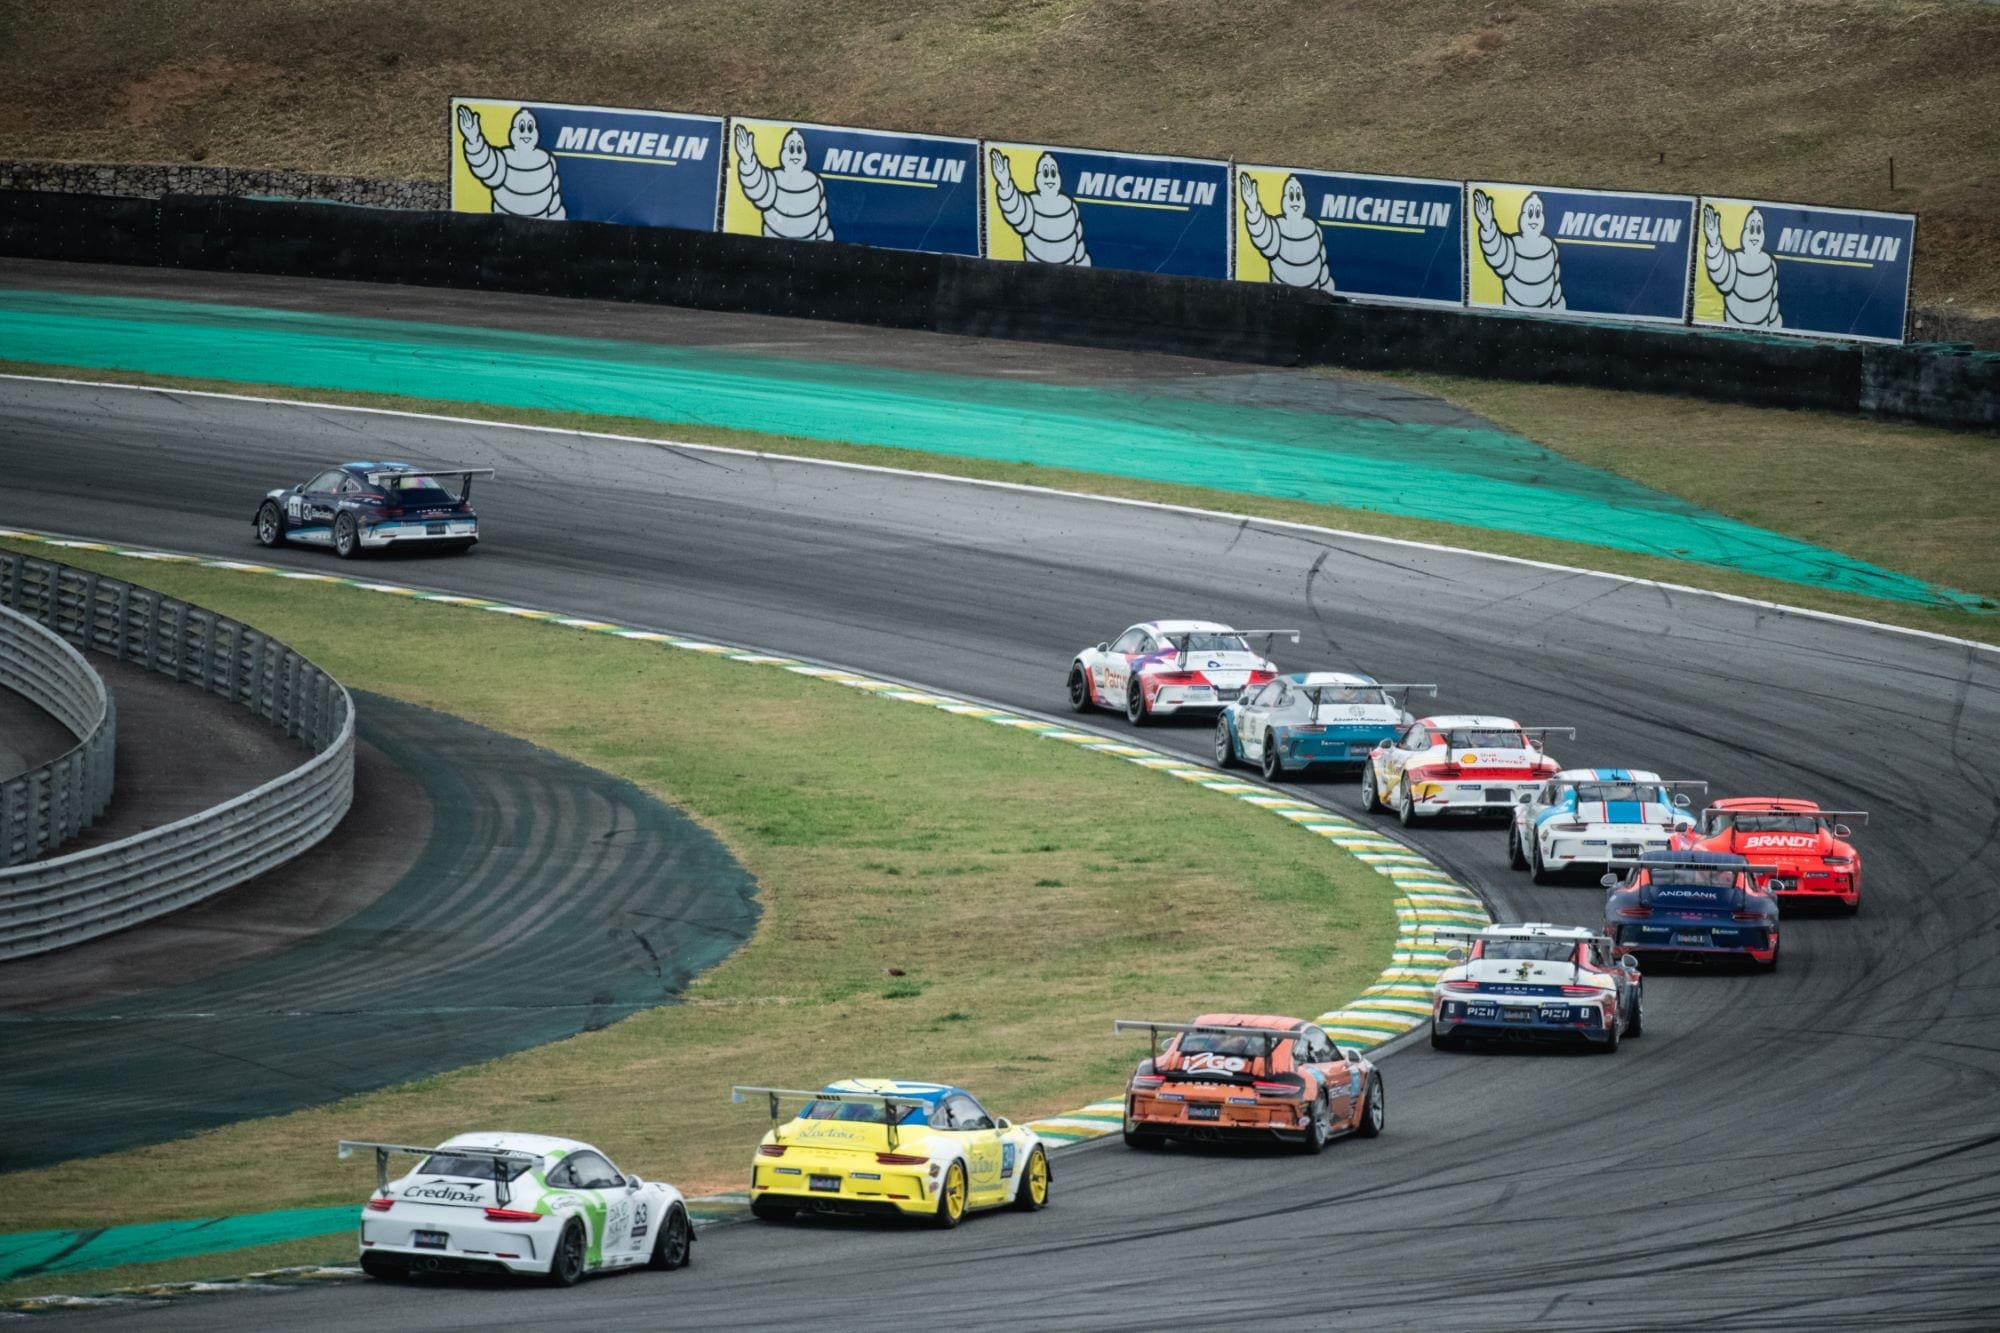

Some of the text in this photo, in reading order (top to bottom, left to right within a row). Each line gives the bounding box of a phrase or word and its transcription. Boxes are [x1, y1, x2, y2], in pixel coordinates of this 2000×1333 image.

[555, 126, 710, 162] MICHELIN
[822, 147, 967, 185] MICHELIN
[1076, 171, 1218, 207] MICHELIN
[1320, 193, 1452, 229] MICHELIN
[1558, 211, 1682, 243] MICHELIN
[1777, 226, 1902, 263] MICHELIN
[290, 503, 298, 515] 11
[1744, 835, 1817, 848] BRANDT
[1658, 890, 1717, 900] ANDBANK
[403, 1185, 486, 1203] Credipar
[634, 1203, 648, 1225] 63
